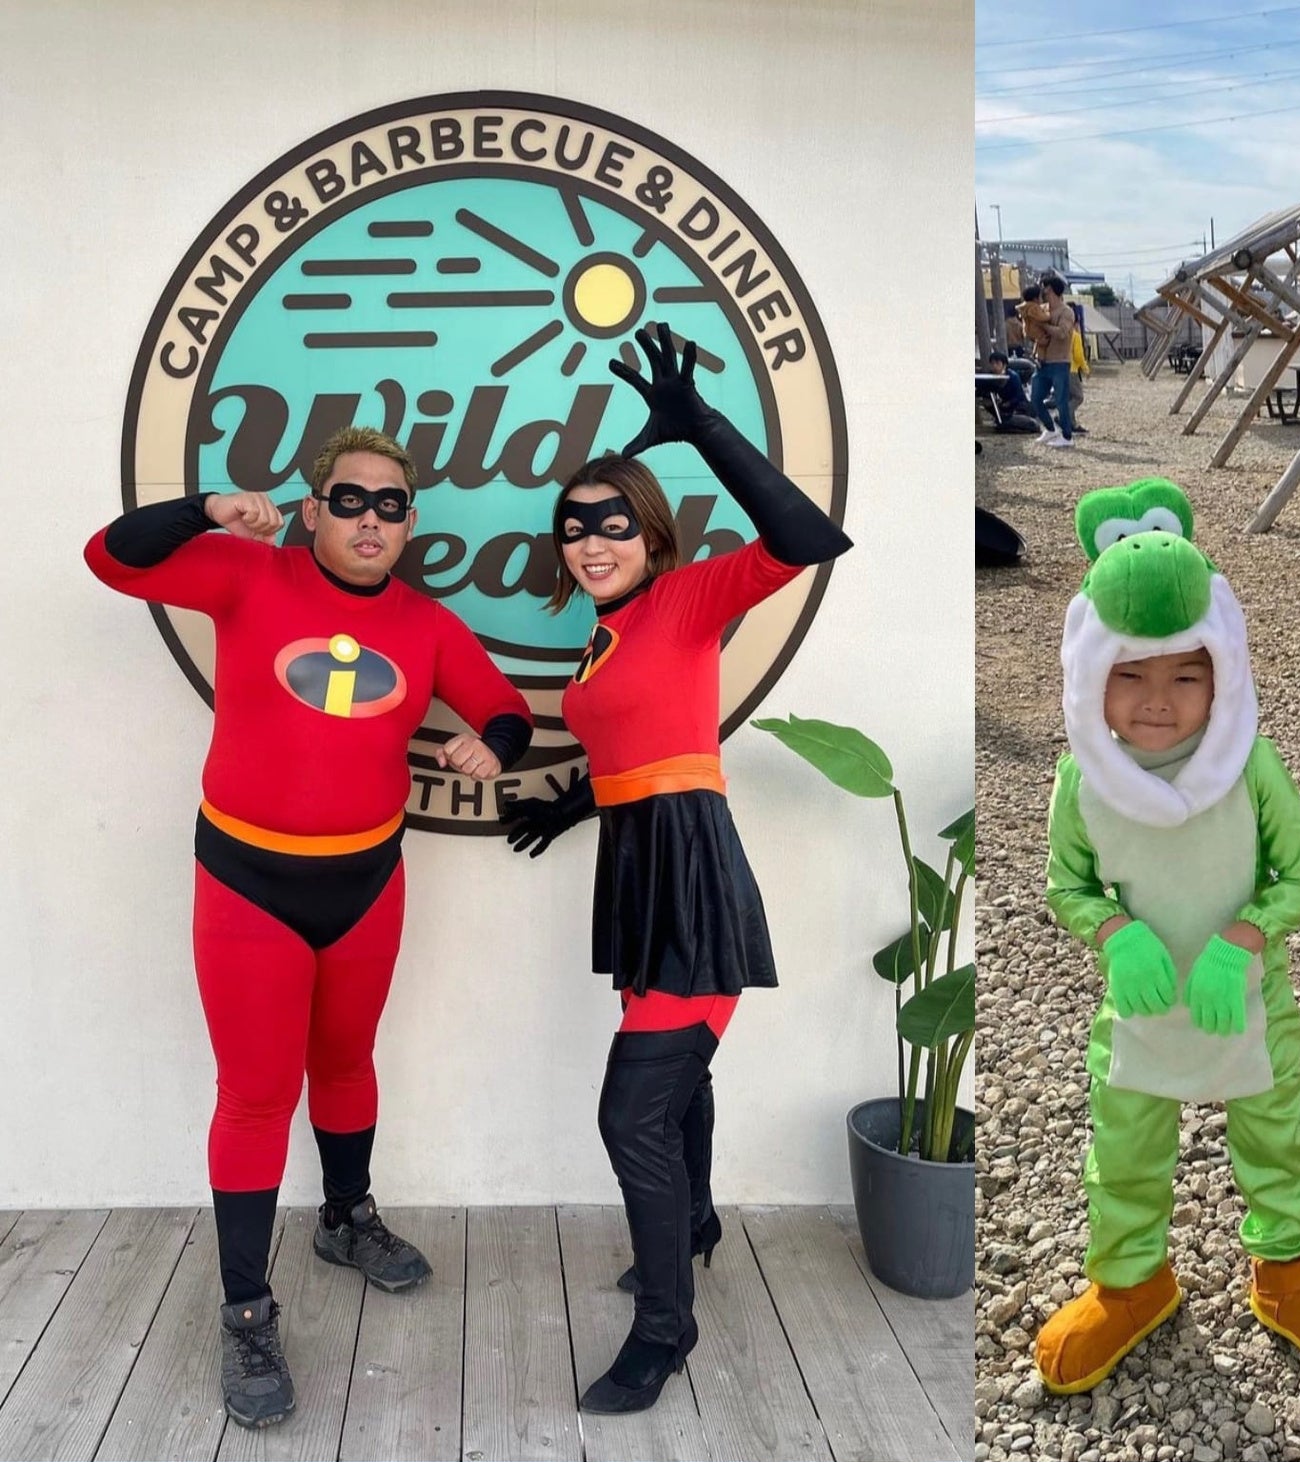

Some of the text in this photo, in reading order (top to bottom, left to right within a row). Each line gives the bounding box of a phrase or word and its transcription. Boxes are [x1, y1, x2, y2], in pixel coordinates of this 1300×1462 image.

[160, 116, 807, 379] CAMP & BARBECUE & DINER
[199, 378, 616, 491] Wild
